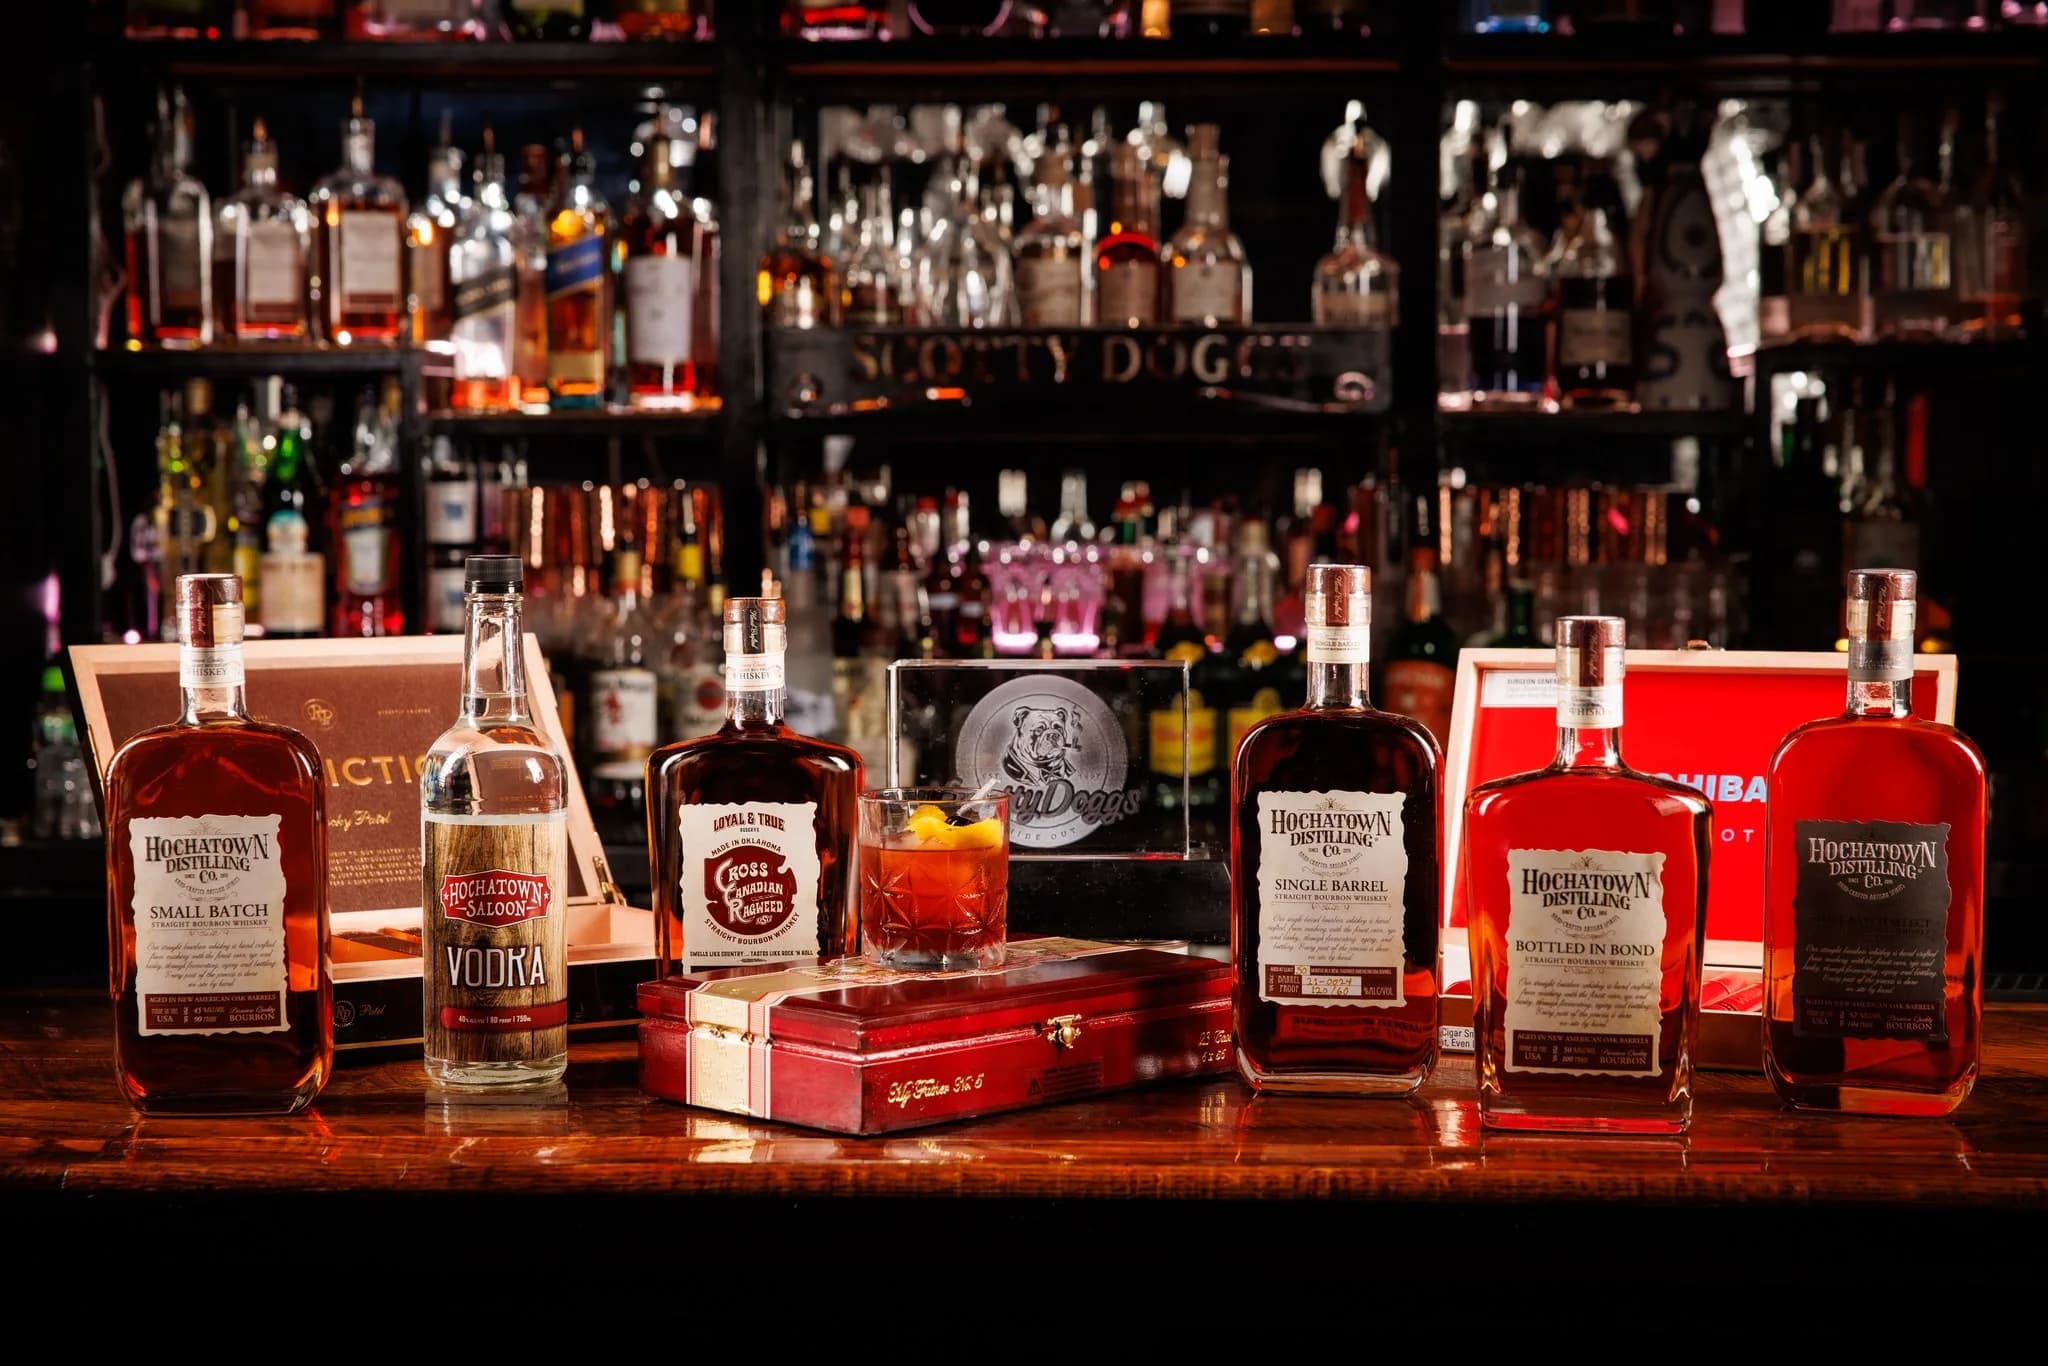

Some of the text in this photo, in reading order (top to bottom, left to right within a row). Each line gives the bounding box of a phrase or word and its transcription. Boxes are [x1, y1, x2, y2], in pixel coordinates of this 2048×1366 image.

[713, 812, 785, 832] LOYAL & TRUE
[1270, 809, 1392, 836] HOCHATOWN
[144, 833, 270, 862] HOCHATOWN
[711, 842, 731, 857] MADE
[741, 838, 782, 853] OKLAHOMA
[1290, 829, 1374, 848] DISTILLING
[1807, 837, 1937, 869] HOCHATOWN
[165, 855, 252, 874] DISTILLING
[1829, 859, 1918, 880] DISTILLING
[714, 857, 769, 893] CROSS
[1521, 868, 1652, 899] HOCHATOWN
[448, 879, 544, 907] HOCHATOWN
[723, 881, 784, 907] CANADIAN
[1274, 878, 1389, 893] SINGLE BARREL
[1354, 894, 1389, 902] WHISKEY
[1542, 890, 1631, 911] DISTILLING
[150, 903, 269, 920] SMALL BATCH
[466, 900, 528, 918] SALOON
[729, 898, 784, 924] RAGWEED
[151, 919, 268, 929] STRAIGHT BOURBON WHISKEY
[703, 917, 737, 943] STRAIGHT
[737, 935, 774, 945] BOURBON
[773, 911, 800, 938] WHISKEY
[1515, 940, 1655, 957] BOTTLED IN BOND
[446, 945, 546, 988] VODKA
[1524, 956, 1645, 967] STRAIGHT BOURBON WHISKEY
[156, 1015, 174, 1024] USA
[229, 1013, 275, 1023] BOURBON
[1886, 1022, 1933, 1031] BOURBON
[1524, 1052, 1542, 1061] USA
[1599, 1056, 1647, 1065] BOURBON
